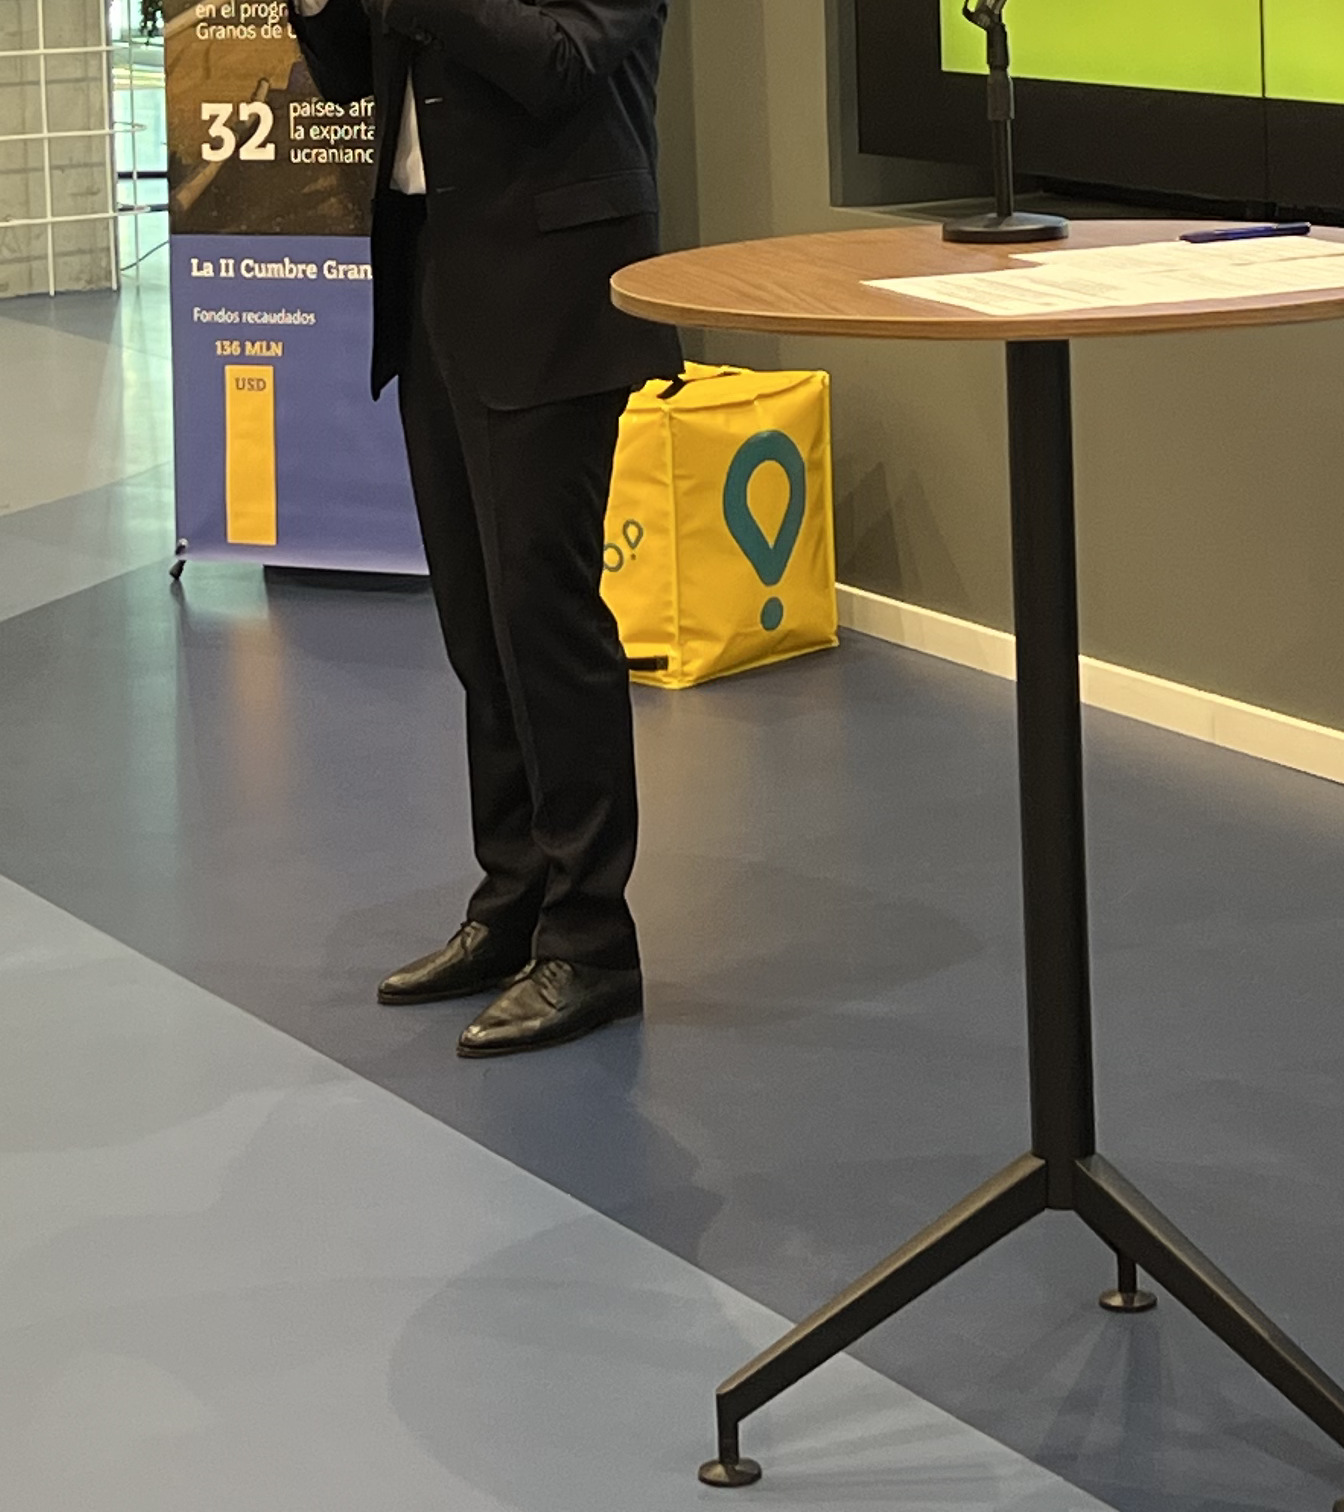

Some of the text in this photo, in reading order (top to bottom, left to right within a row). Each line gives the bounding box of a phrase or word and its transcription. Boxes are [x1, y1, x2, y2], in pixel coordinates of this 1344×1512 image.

[195, 3, 216, 19] en
[239, 0, 289, 24] progr
[195, 21, 257, 40] Granos
[260, 20, 283, 39] de
[289, 96, 376, 120] países afr
[200, 100, 276, 162] 32
[289, 119, 376, 145] la exporta
[190, 256, 374, 281] La II Cumbre Gran
[192, 306, 317, 326] Fondos recaudados
[244, 339, 284, 357] MLN
[234, 376, 267, 392] USD
